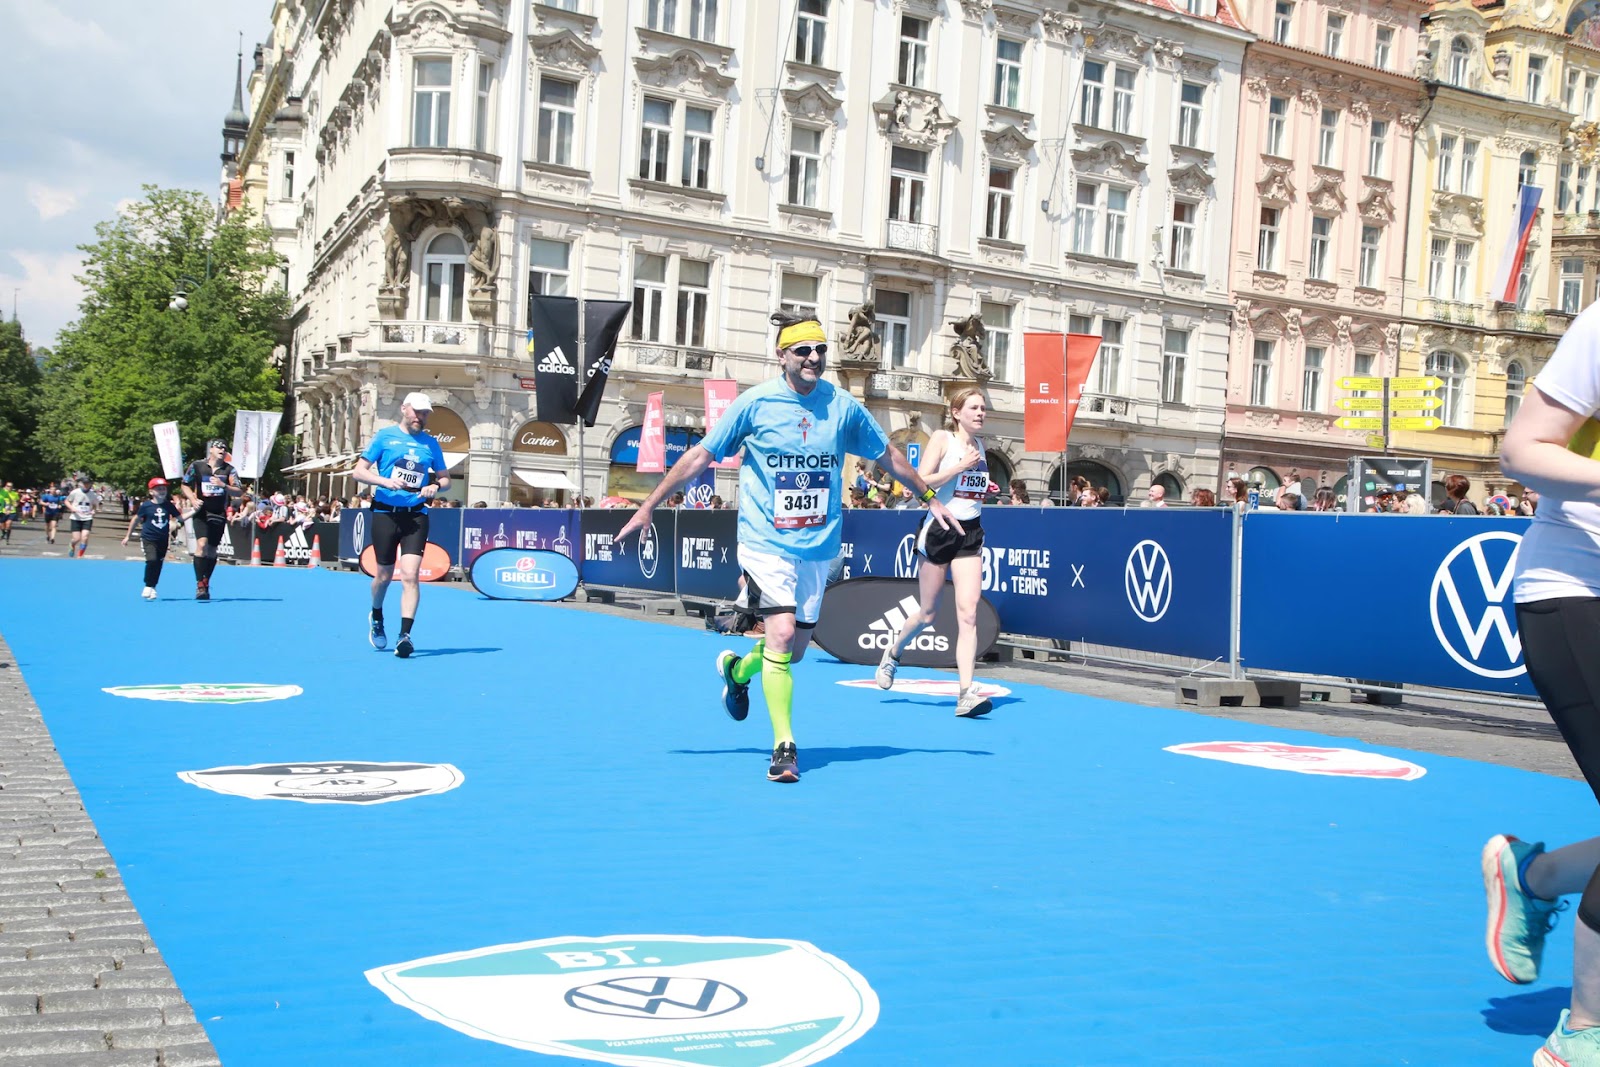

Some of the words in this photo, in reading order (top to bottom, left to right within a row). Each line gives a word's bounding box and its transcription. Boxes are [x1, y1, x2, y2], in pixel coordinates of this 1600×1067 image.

[538, 363, 575, 375] adidas
[521, 432, 559, 447] Cartier
[766, 451, 839, 469] CITROËN
[909, 446, 918, 465] P
[960, 475, 987, 488] F1538
[784, 494, 819, 511] 3431
[1008, 548, 1050, 569] BATTLE
[501, 571, 549, 584] BIRELL
[1019, 568, 1028, 576] OF
[1027, 568, 1038, 577] THE
[1011, 576, 1048, 597] TEAMS
[542, 946, 662, 969] BT.
[605, 1035, 685, 1048] VOLKSWAGEN
[686, 1032, 731, 1042] PRAGUE
[731, 1026, 792, 1038] MARATHON
[793, 1022, 820, 1031] 2022
